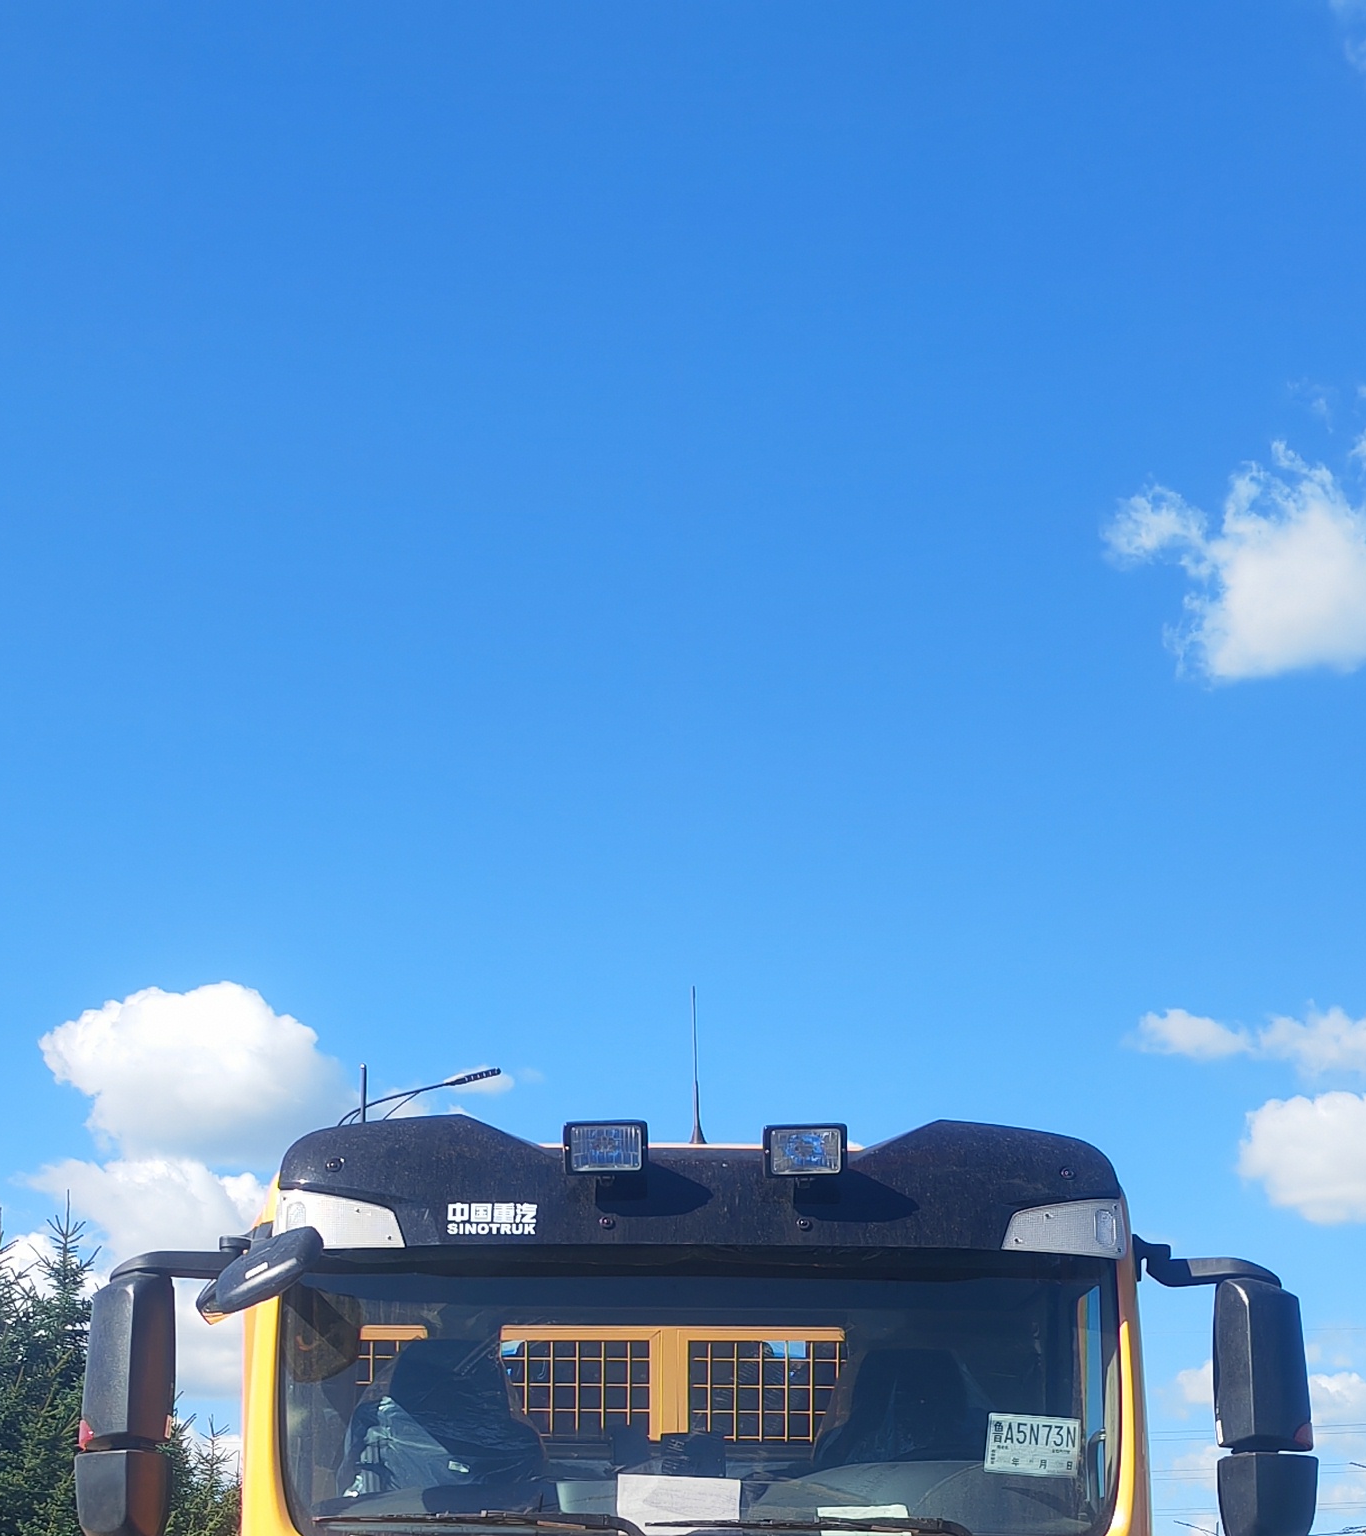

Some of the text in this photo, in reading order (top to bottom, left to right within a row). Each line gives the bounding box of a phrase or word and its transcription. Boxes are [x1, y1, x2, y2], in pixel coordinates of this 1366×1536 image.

[447, 1202, 537, 1223] 中国重汽
[447, 1223, 536, 1235] SINOTRUK
[992, 1421, 1077, 1448] 鲁A5N73N
